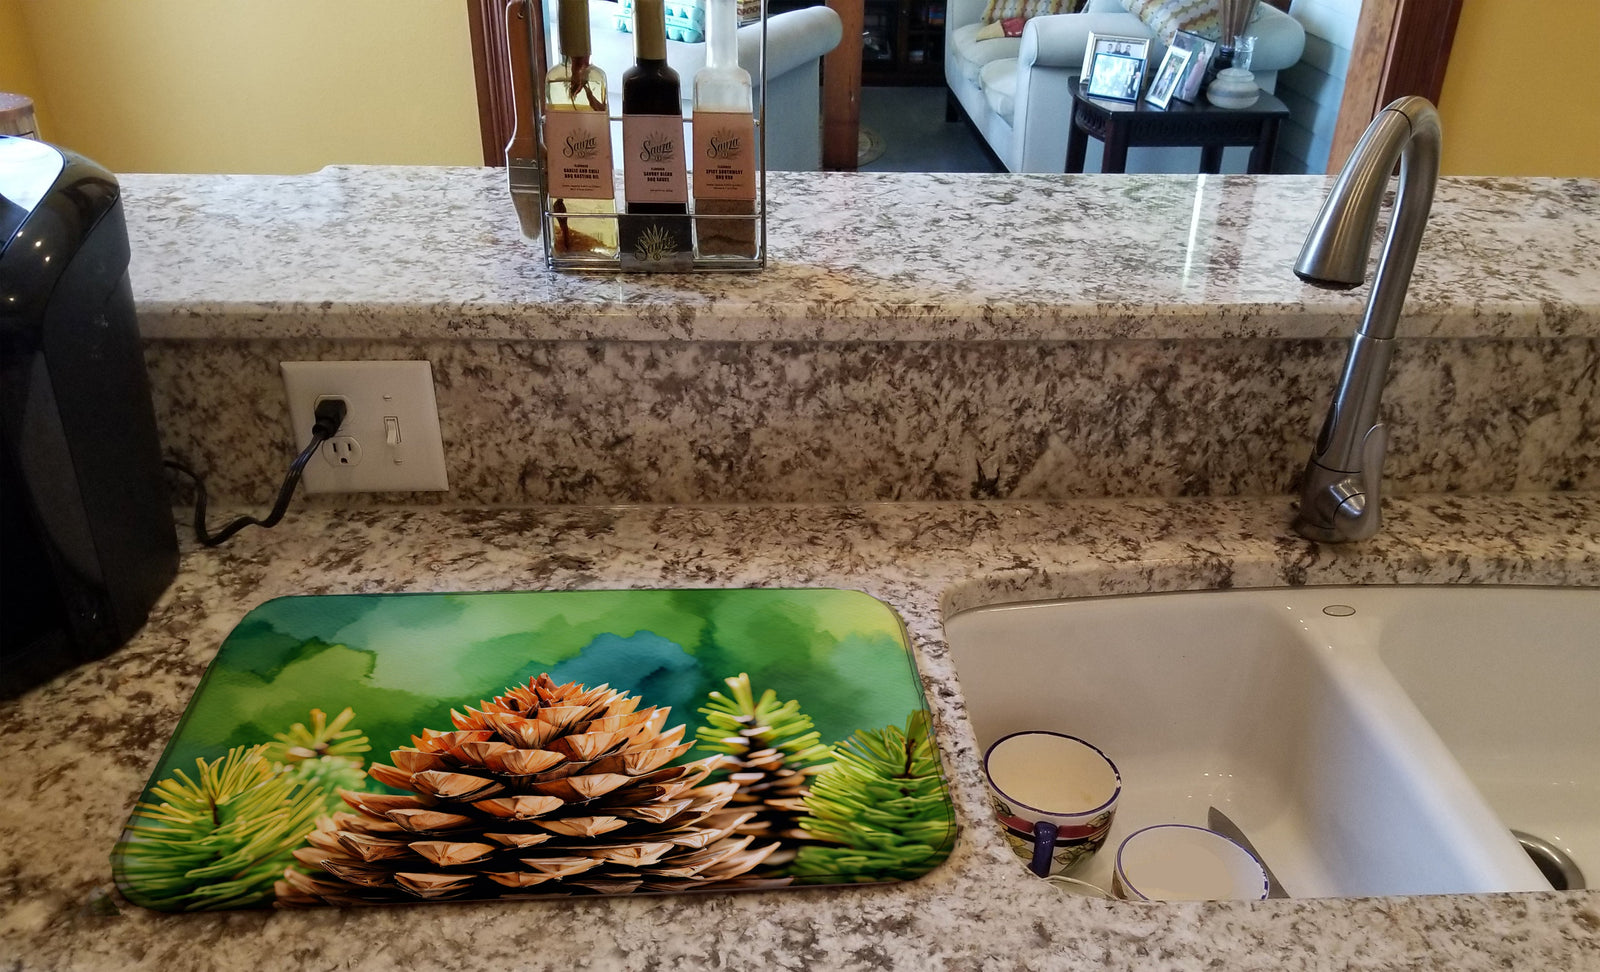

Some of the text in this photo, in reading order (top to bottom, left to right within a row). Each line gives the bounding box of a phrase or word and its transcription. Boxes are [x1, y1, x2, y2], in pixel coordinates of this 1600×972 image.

[563, 136, 597, 158] Sauza
[640, 140, 674, 161] Sauza
[707, 137, 740, 158] Sauza
